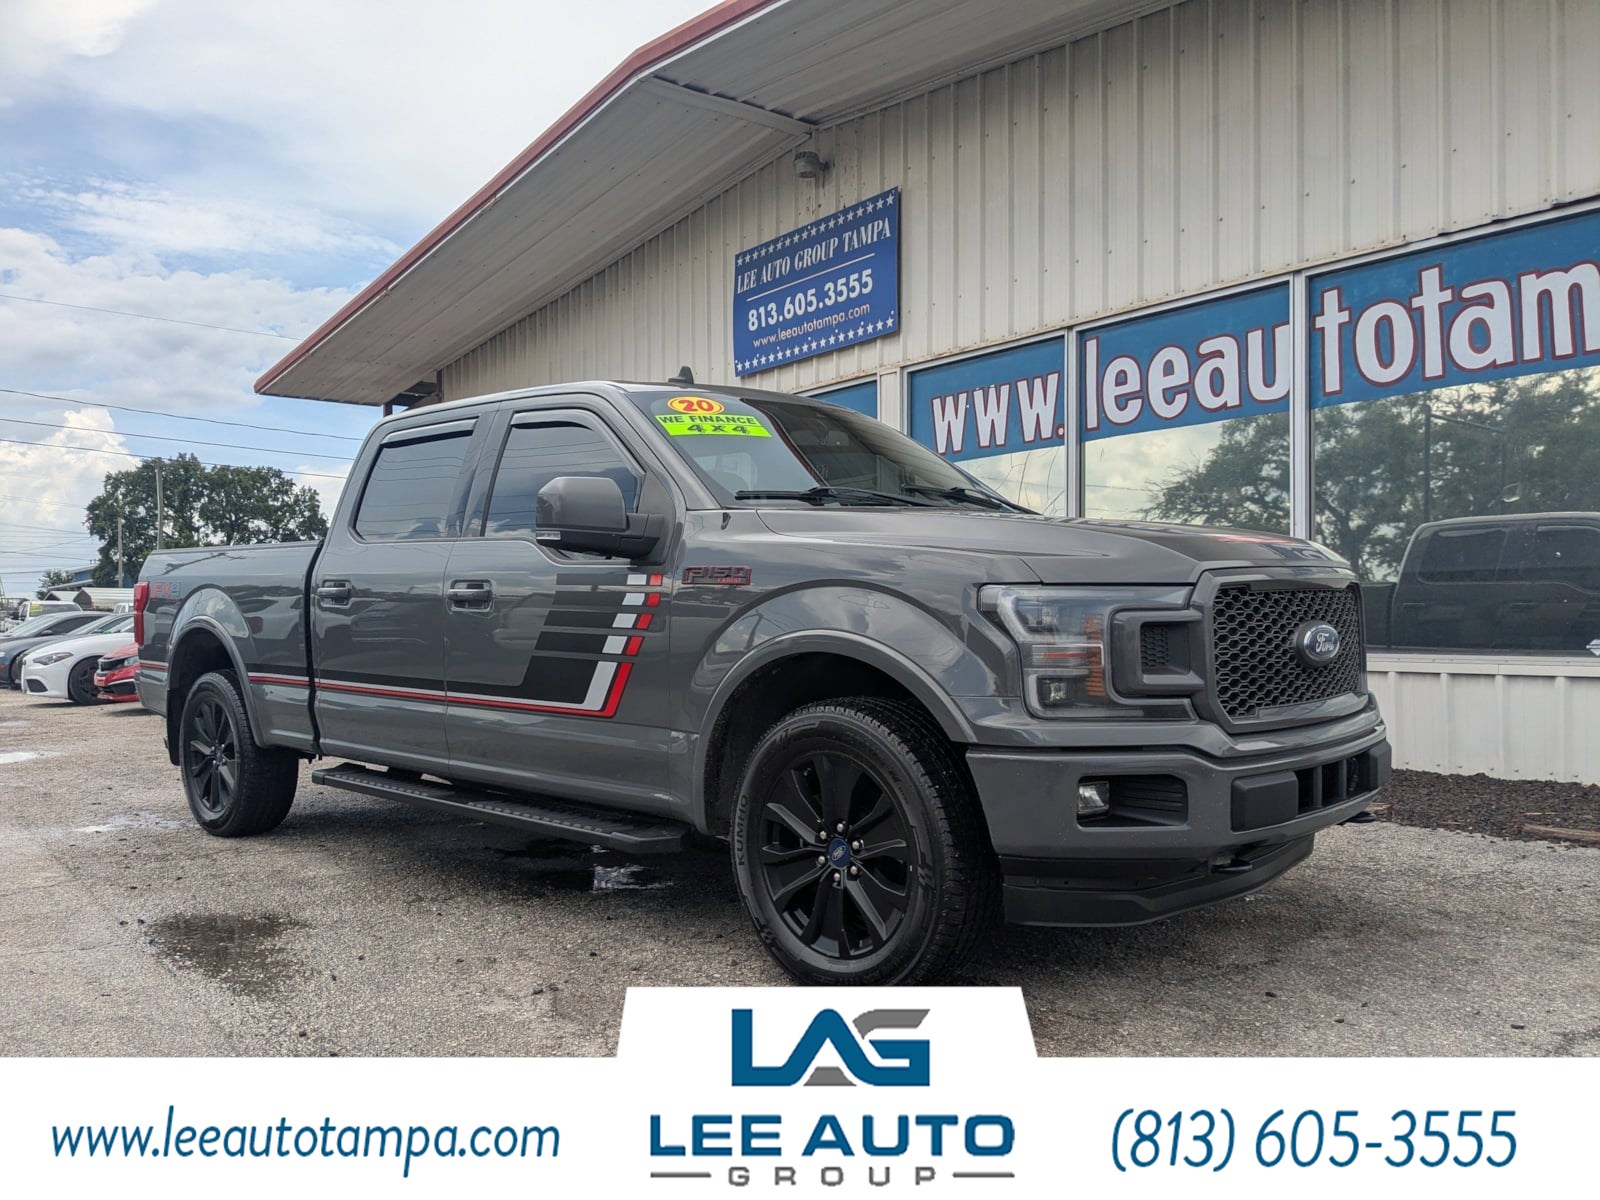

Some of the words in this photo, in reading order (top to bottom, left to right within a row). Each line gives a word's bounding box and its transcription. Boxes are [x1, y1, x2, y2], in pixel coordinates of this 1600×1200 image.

[737, 268, 758, 295] LEE
[760, 256, 791, 285] AUTO
[794, 237, 839, 271] GROUP
[842, 216, 892, 253] TAMPA
[748, 268, 873, 332] 813.605.3555
[752, 303, 871, 348] www.leeautotampa.com
[658, 416, 685, 424] WE
[689, 415, 757, 425] FINANCE
[678, 399, 714, 412] 20
[1315, 632, 1336, 653] Ford
[736, 793, 749, 867] KUMHO
